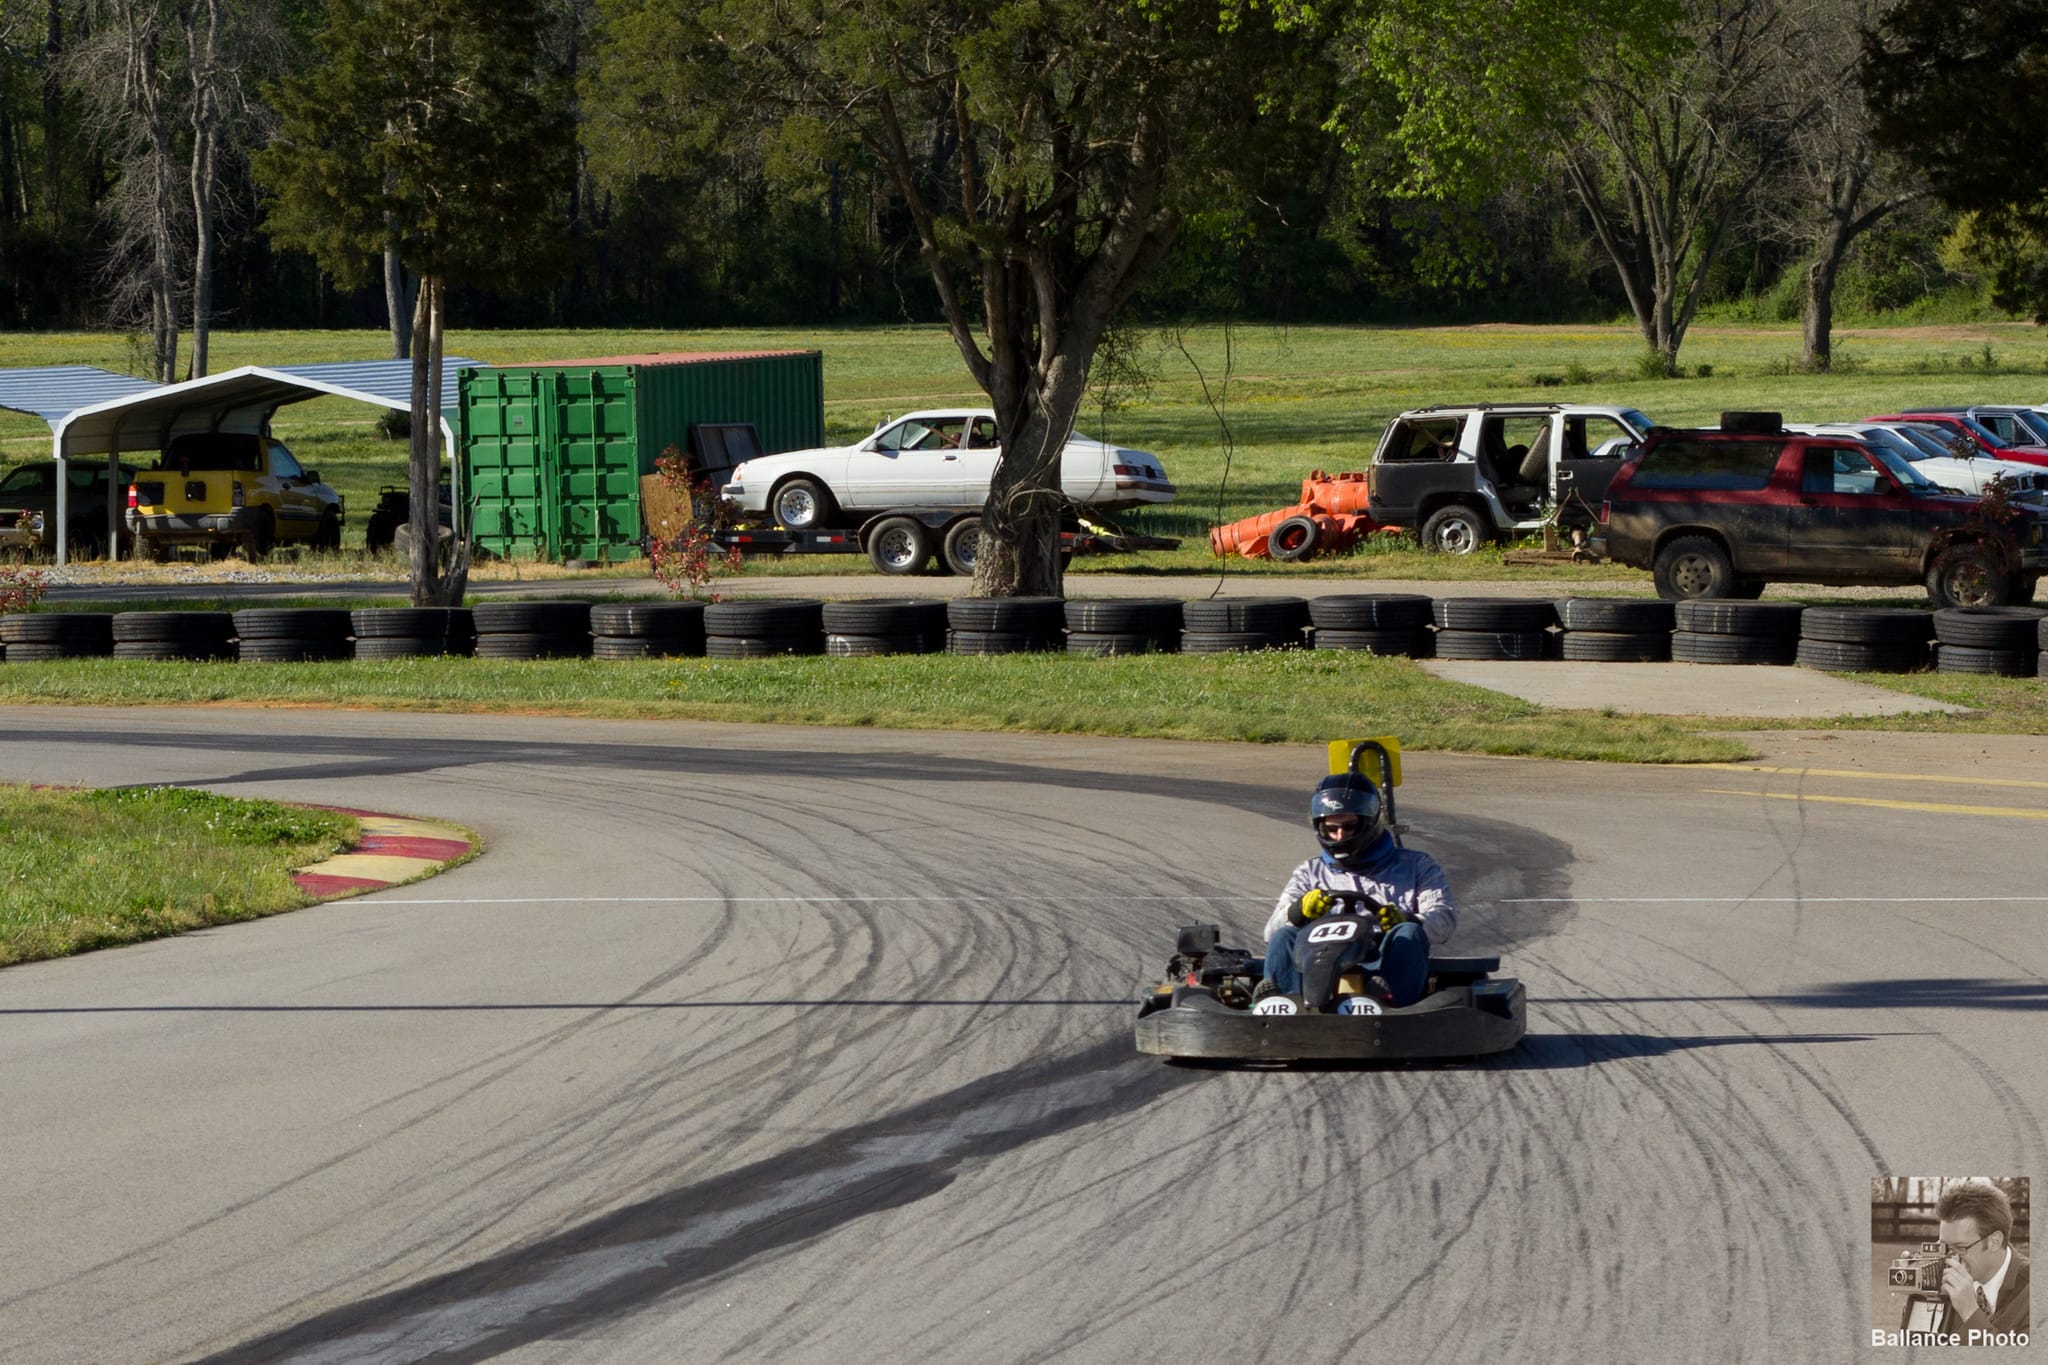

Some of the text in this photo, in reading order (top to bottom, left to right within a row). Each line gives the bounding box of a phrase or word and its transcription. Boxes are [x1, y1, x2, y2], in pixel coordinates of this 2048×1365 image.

[1312, 925, 1349, 938] 44
[1260, 1004, 1290, 1015] VIR
[1343, 1004, 1375, 1015] VIR
